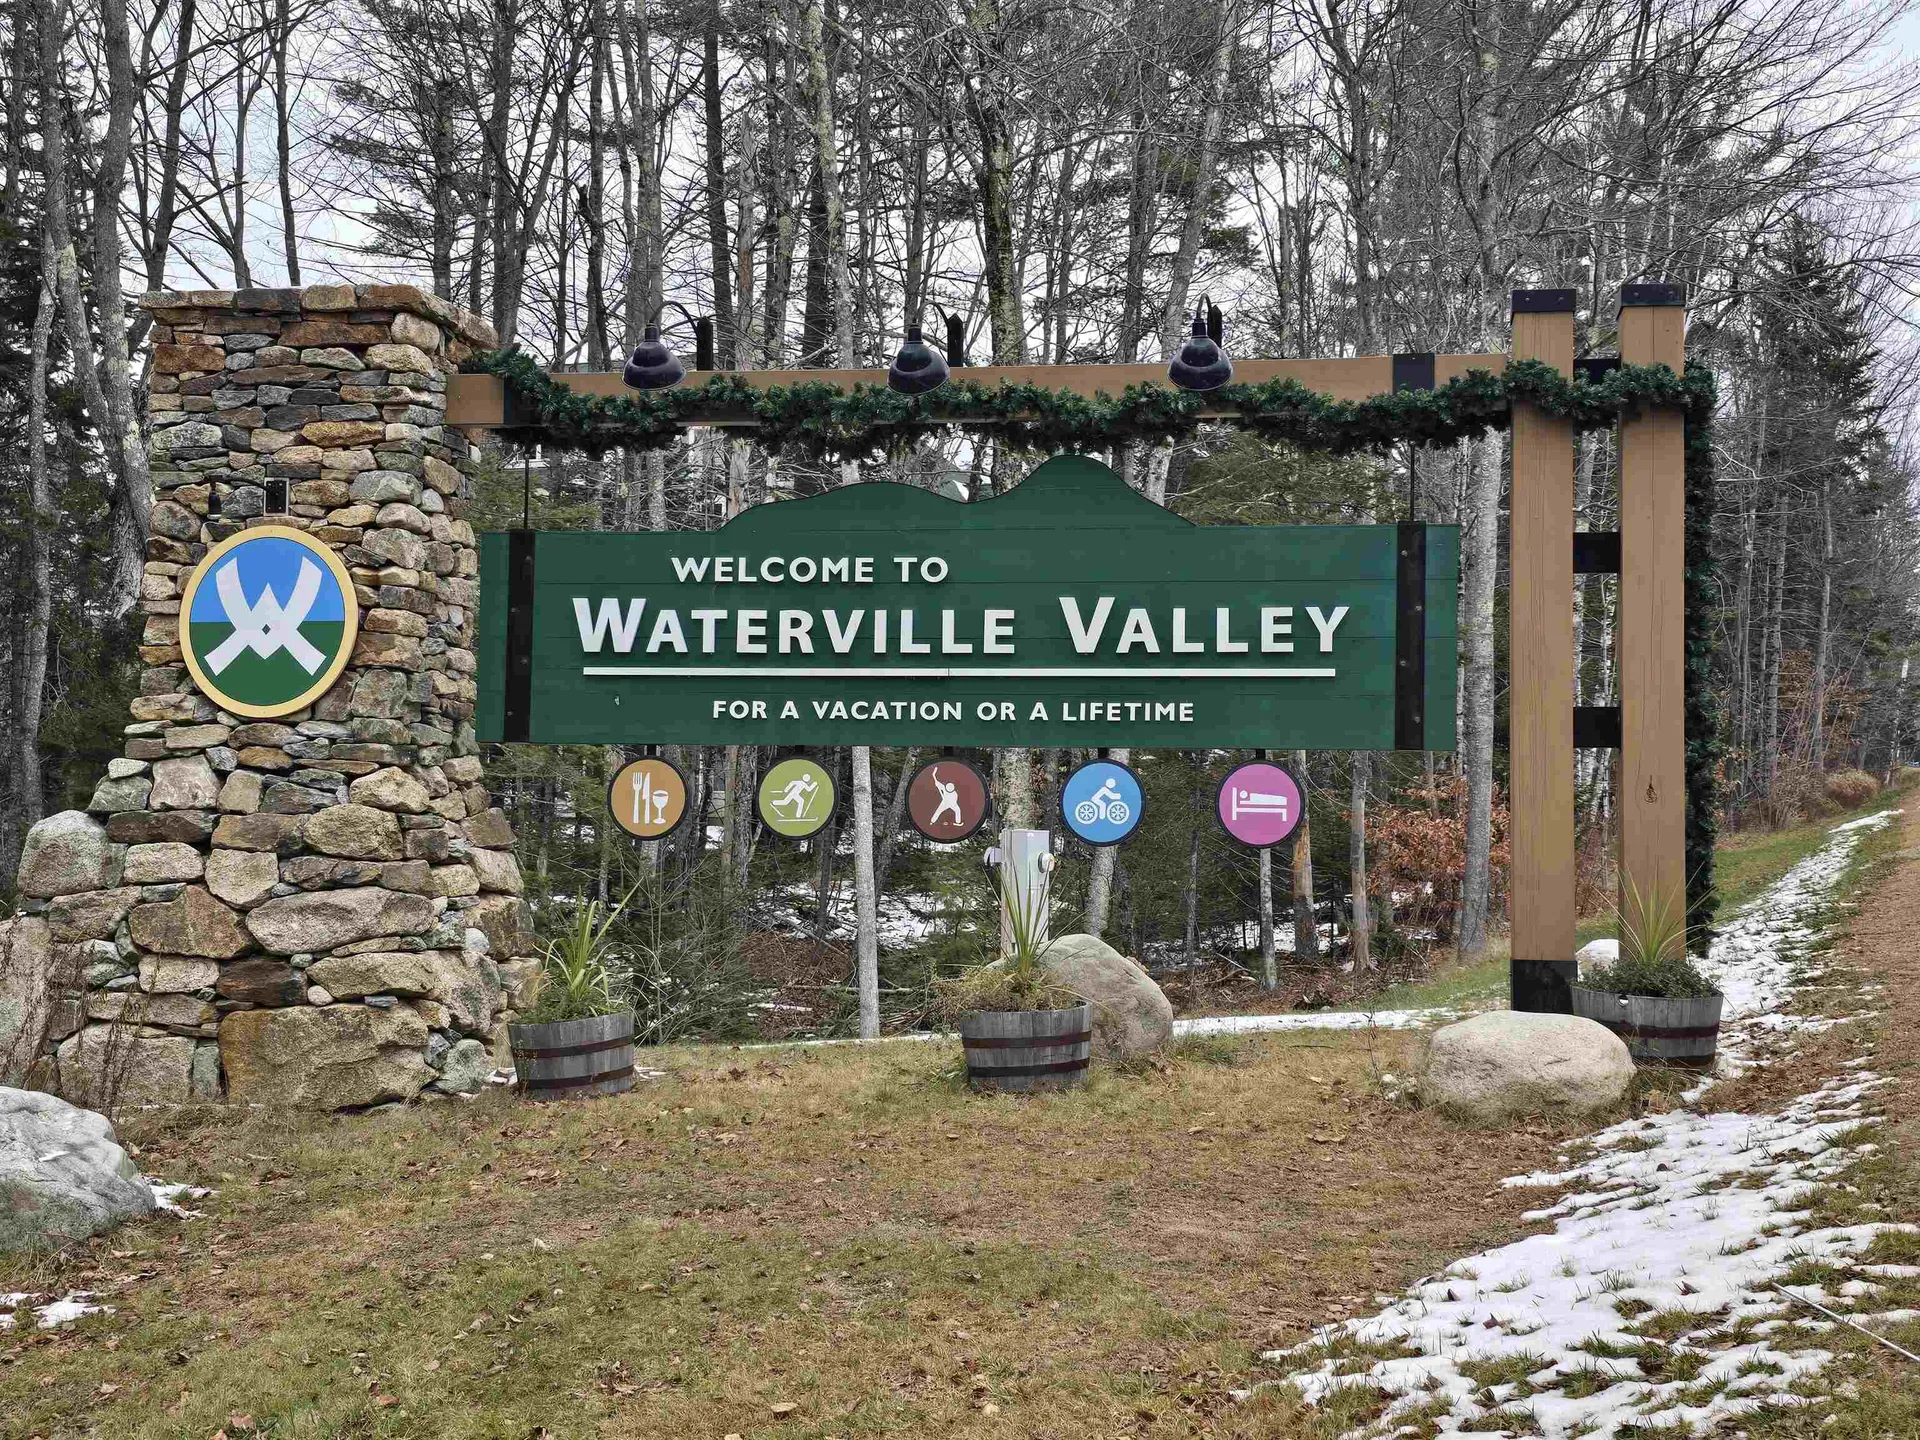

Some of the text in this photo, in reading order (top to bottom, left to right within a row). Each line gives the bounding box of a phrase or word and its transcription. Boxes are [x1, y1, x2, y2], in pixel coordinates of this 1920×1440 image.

[671, 556, 949, 583] WELCOME TO
[573, 596, 1350, 654] WATERVILLE VALLEY
[713, 700, 1194, 722] FOR A VACATION OR A LIFETIME
